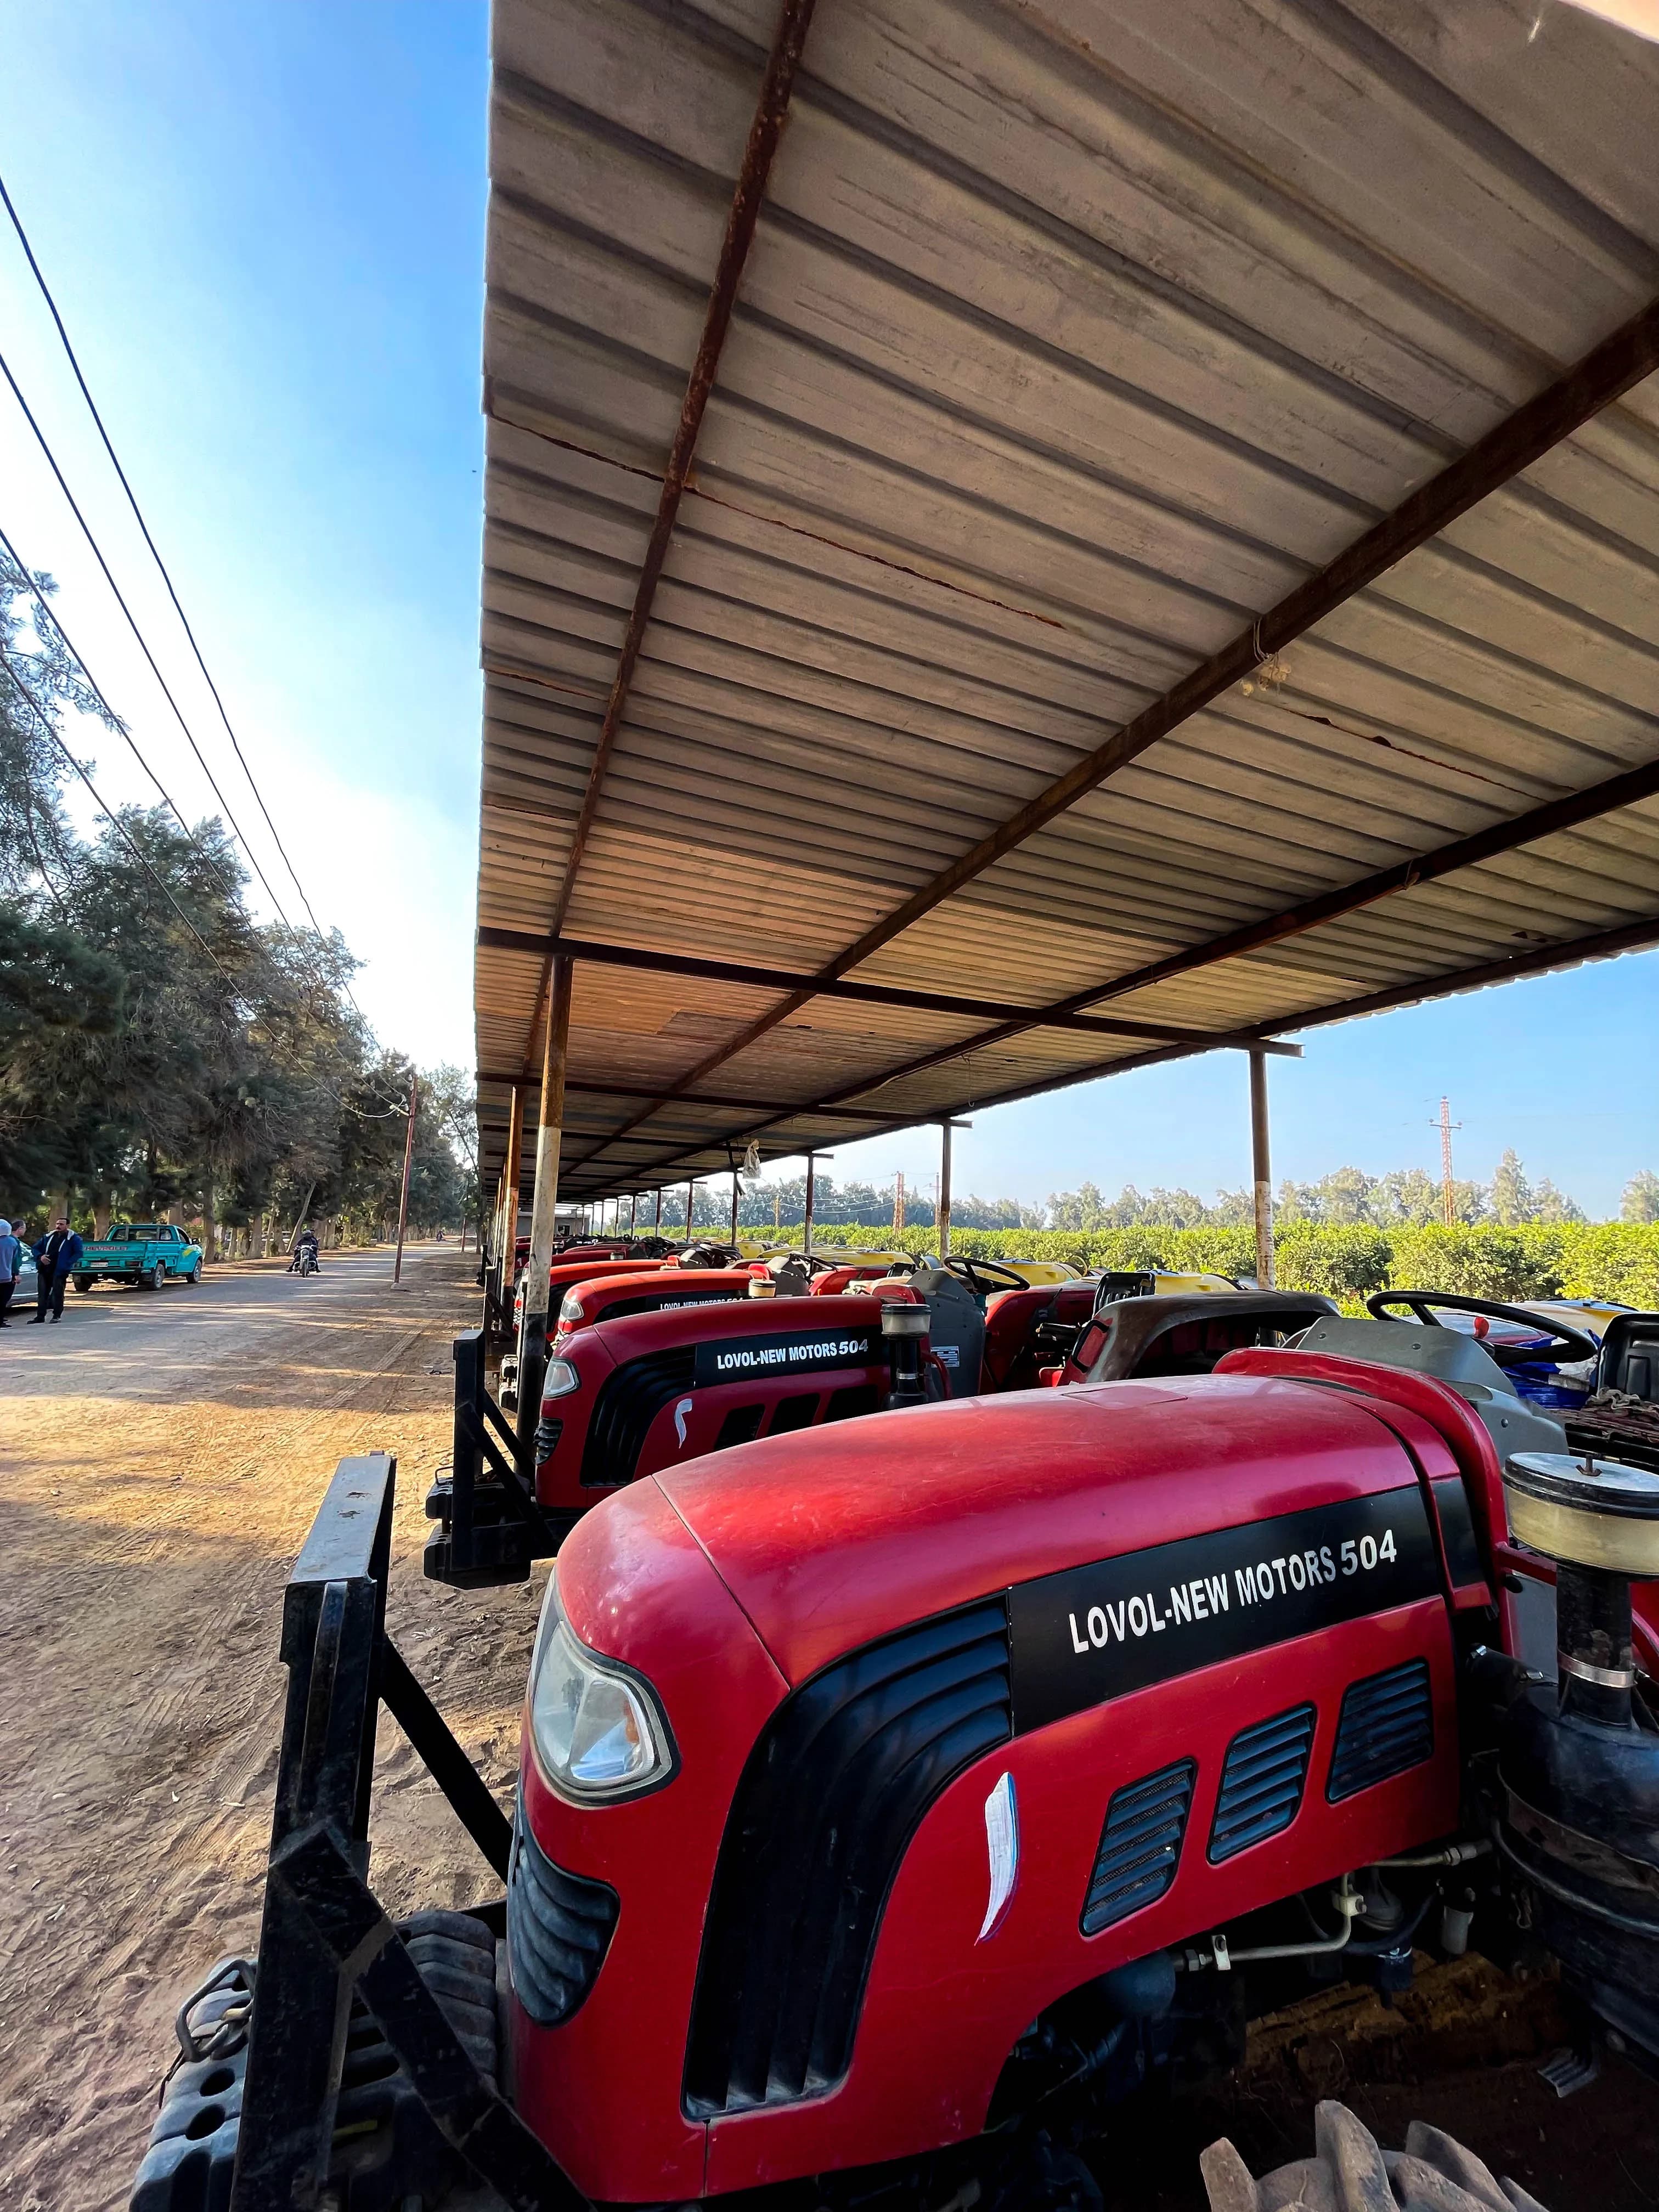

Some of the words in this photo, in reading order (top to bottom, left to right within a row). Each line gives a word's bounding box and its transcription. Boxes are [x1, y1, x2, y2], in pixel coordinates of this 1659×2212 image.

[717, 1348, 786, 1369] LOVOL-NEW
[788, 1342, 837, 1361] MOTORS
[839, 1339, 868, 1355] 504
[1069, 1573, 1229, 1654] LOVOL-NEW
[1234, 1546, 1336, 1606] MOTORS
[1340, 1529, 1397, 1576] 504
